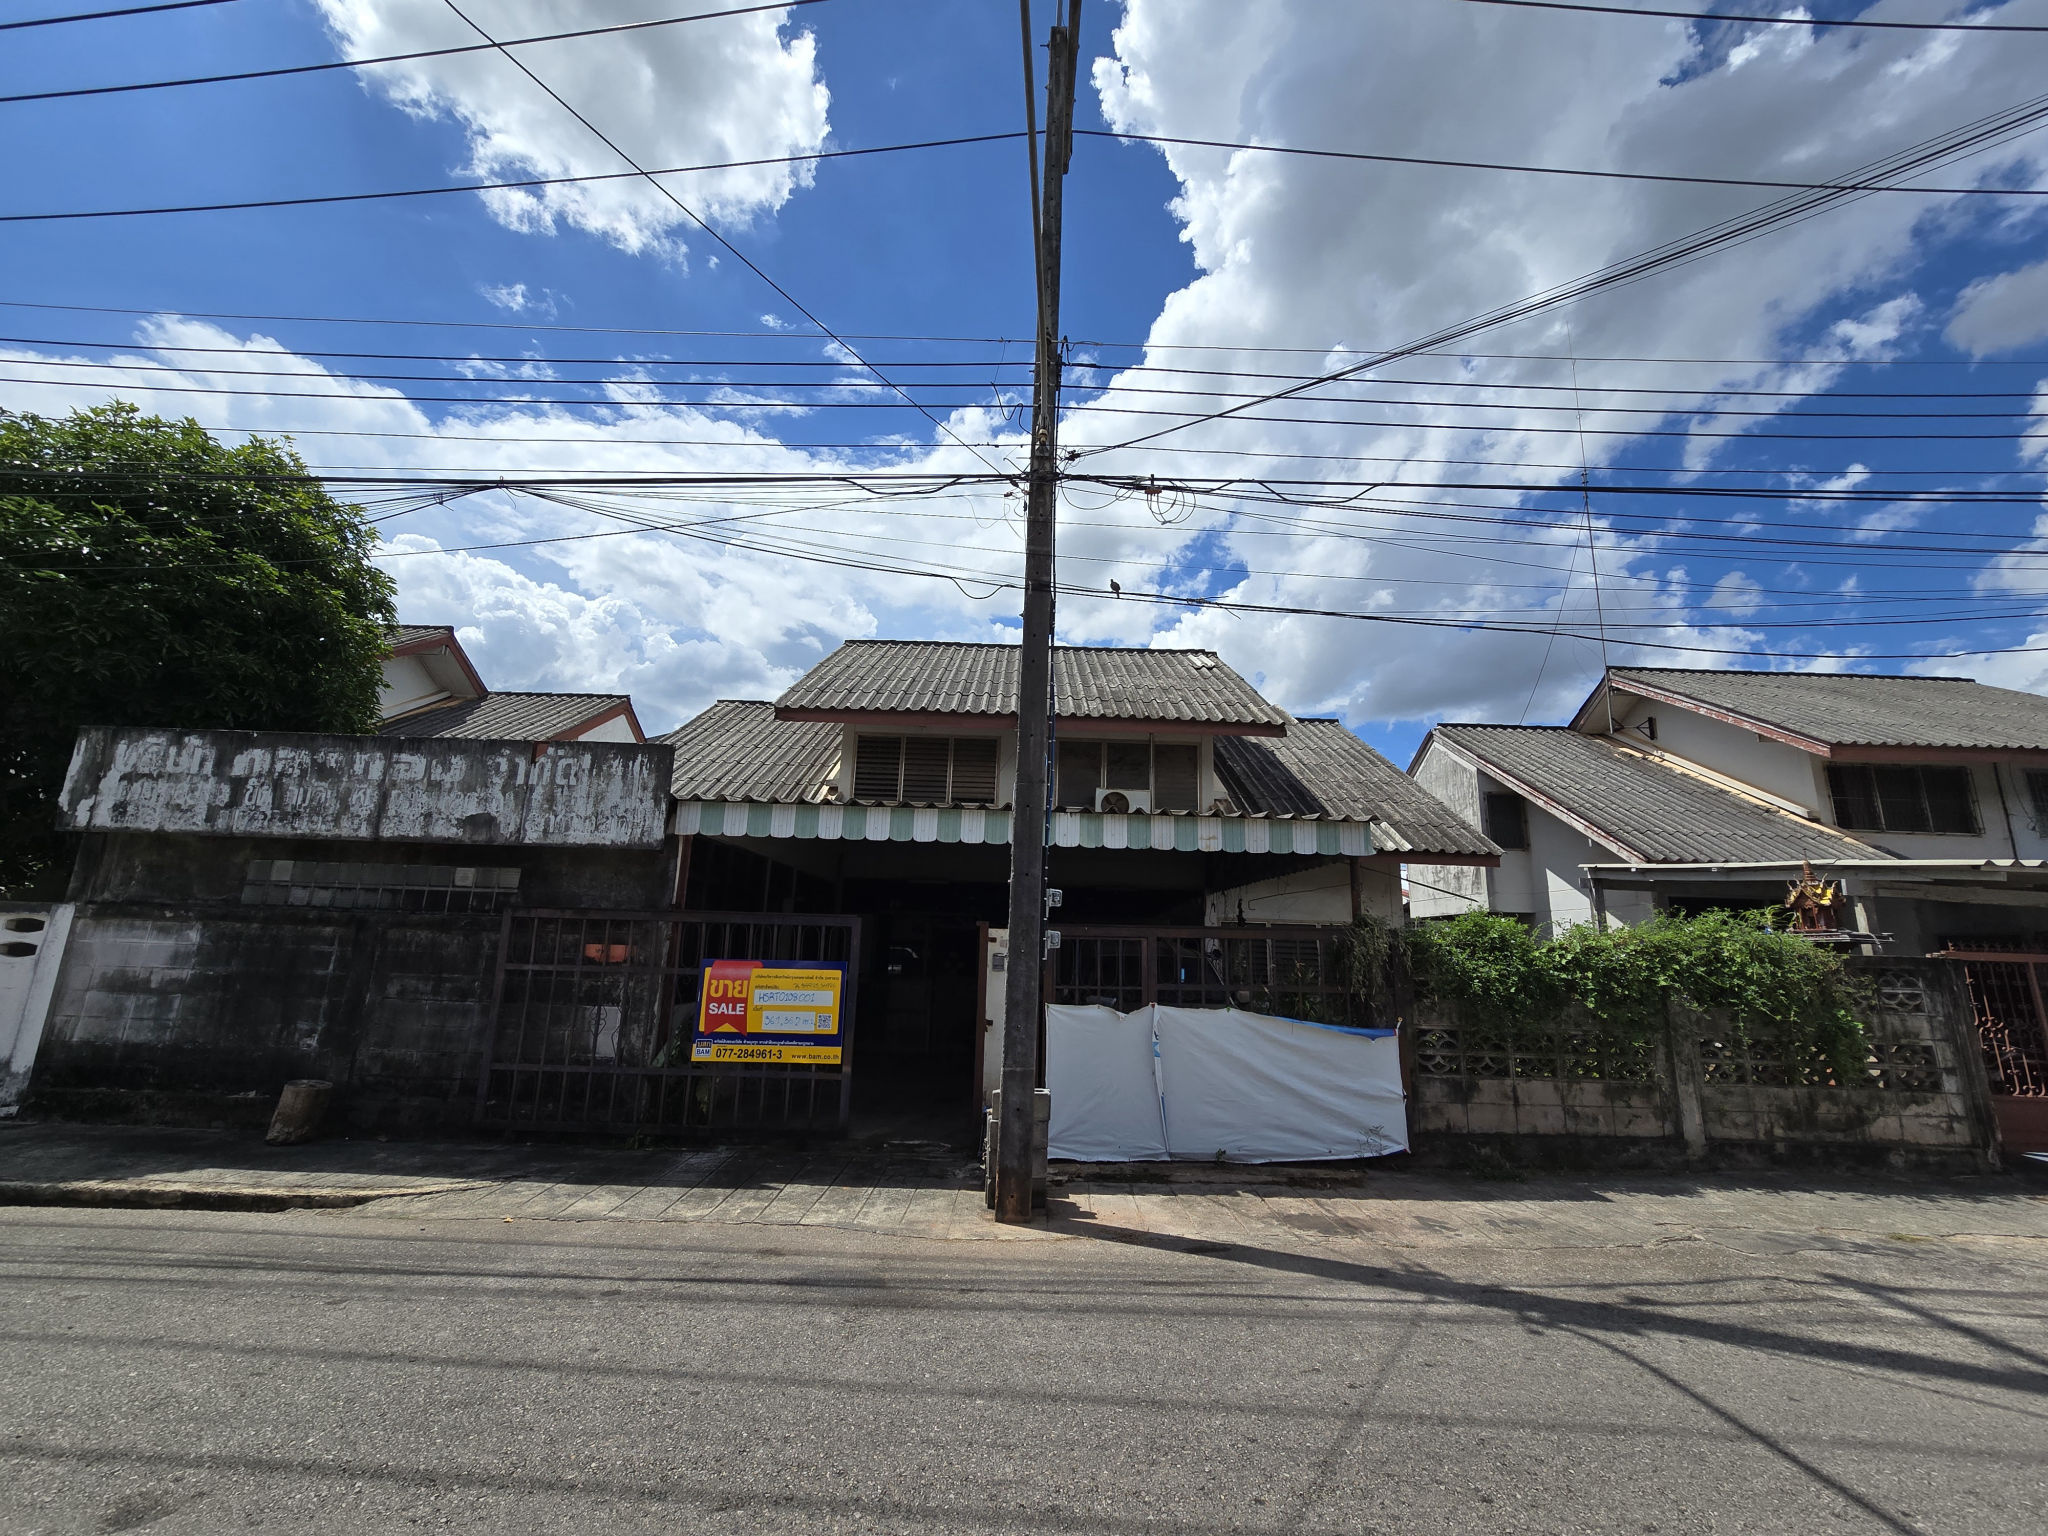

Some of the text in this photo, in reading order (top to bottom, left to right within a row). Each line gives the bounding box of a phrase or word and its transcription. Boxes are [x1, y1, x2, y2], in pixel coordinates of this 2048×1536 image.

[709, 979, 748, 998] ขาย
[708, 1002, 745, 1015] SALE
[715, 1047, 840, 1061] 077-284961-3 www.bam.co.th
